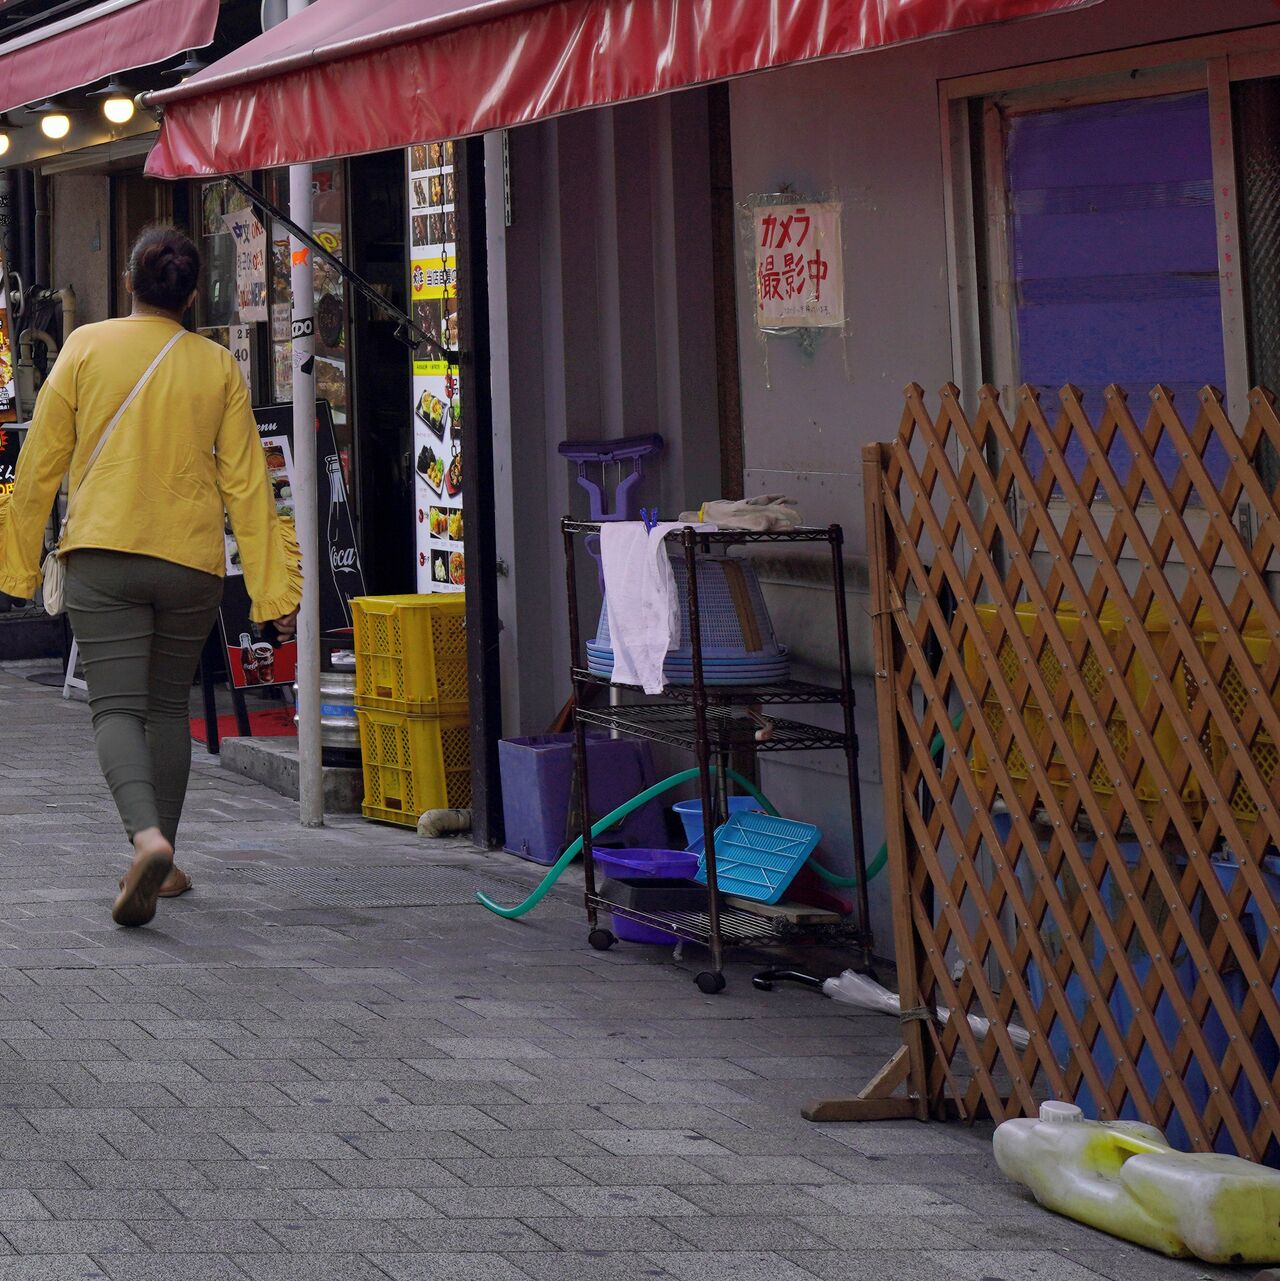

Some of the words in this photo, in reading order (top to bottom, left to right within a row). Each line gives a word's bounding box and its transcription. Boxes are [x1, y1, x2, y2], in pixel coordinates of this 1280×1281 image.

[761, 207, 811, 249] カメラ
[758, 248, 829, 311] 撮影中
